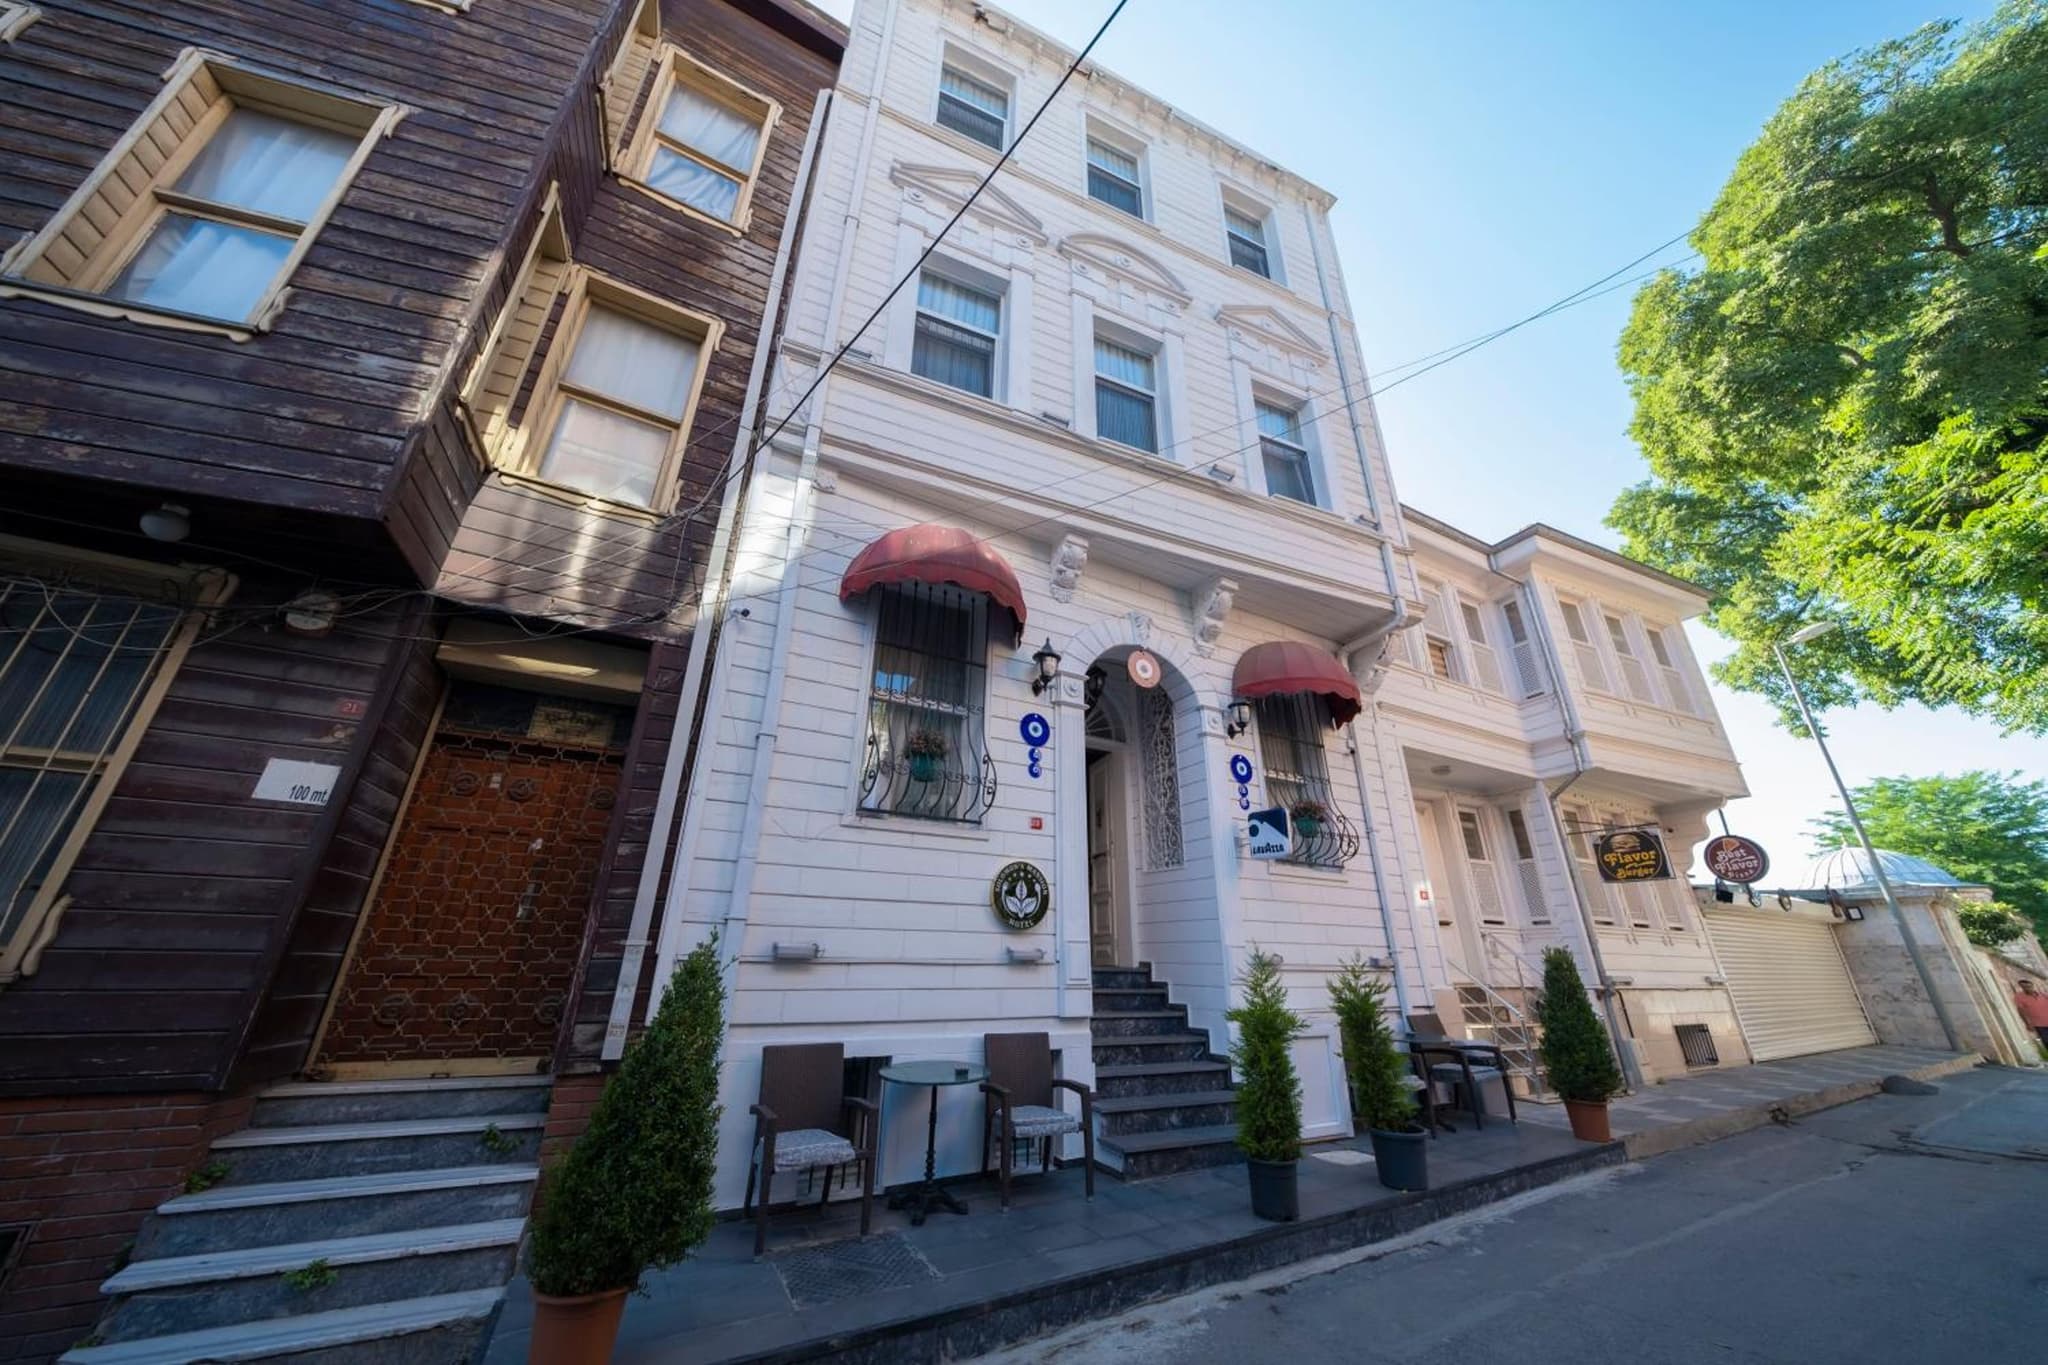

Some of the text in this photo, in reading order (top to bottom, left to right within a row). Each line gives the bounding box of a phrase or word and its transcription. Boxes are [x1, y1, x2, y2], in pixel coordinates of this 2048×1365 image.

[289, 784, 310, 800] 100
[1604, 850, 1656, 867] Flavor
[1715, 860, 1758, 874] Flavor
